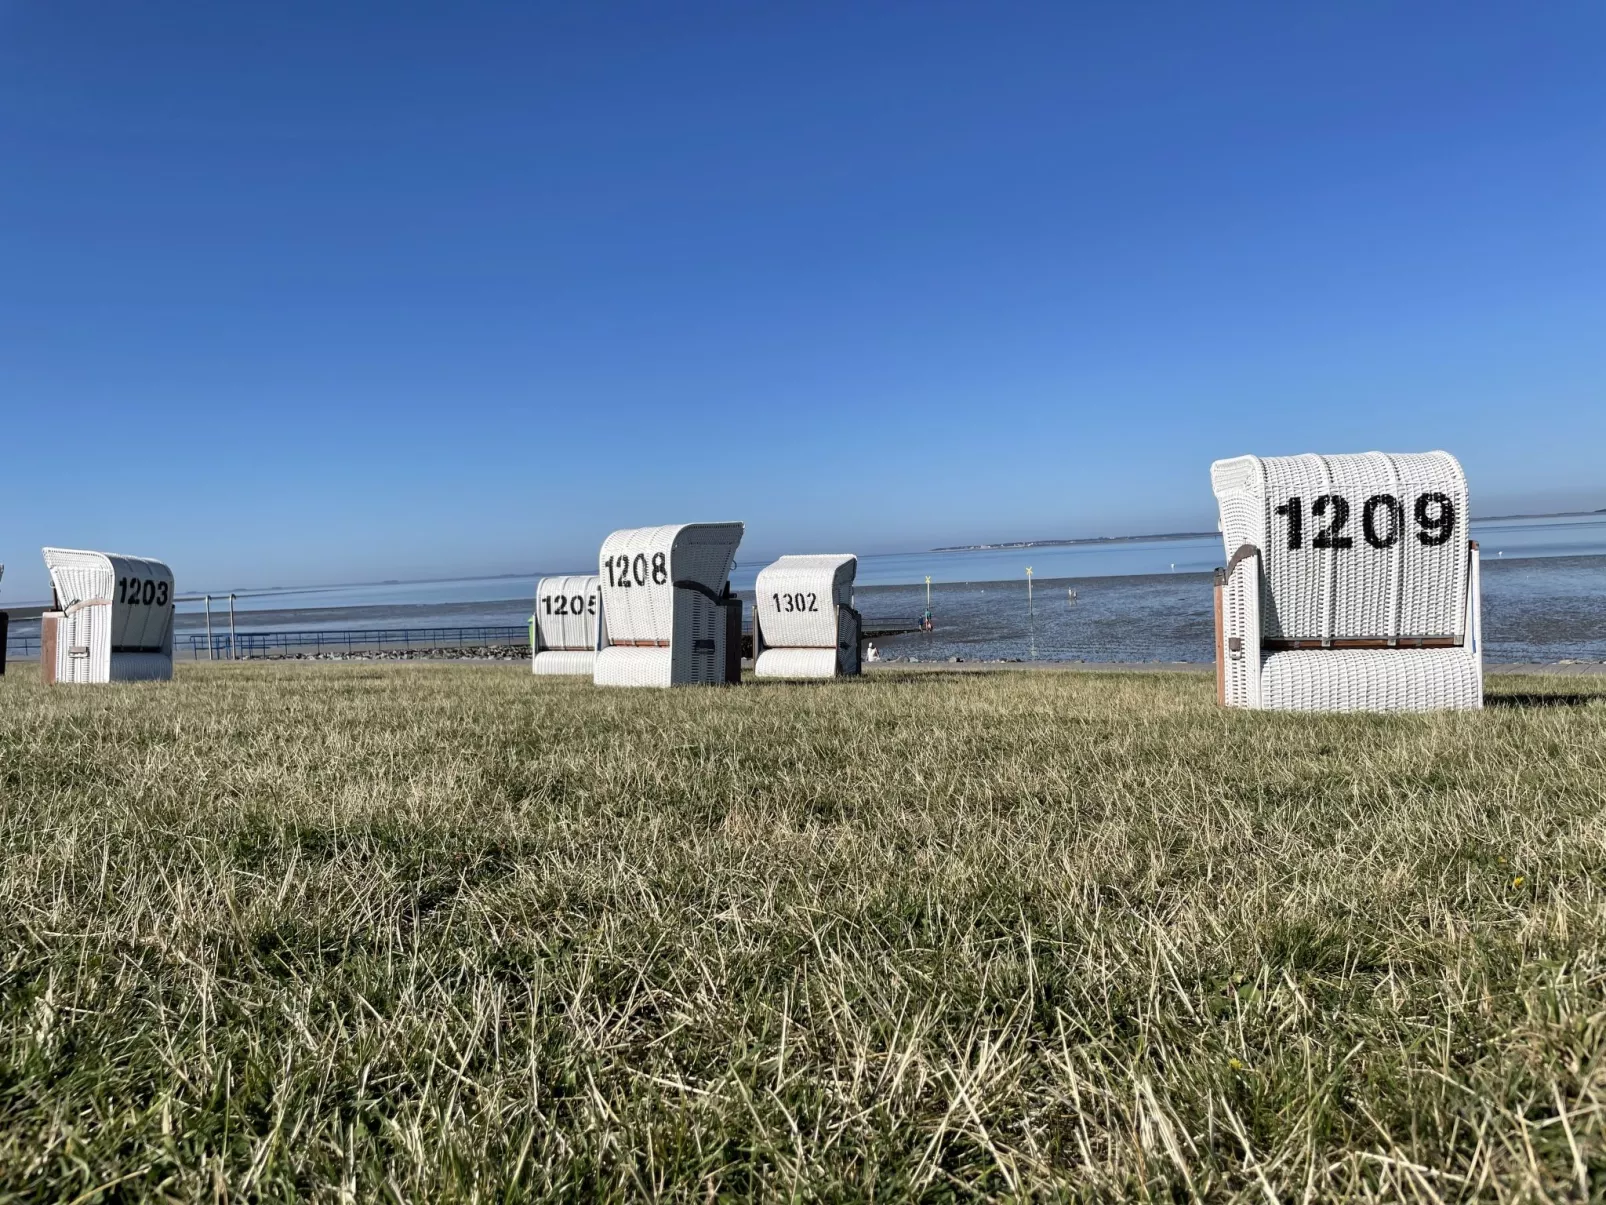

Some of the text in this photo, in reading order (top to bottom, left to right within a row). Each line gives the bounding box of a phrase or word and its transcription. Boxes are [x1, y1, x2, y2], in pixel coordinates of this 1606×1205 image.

[1275, 492, 1455, 550] 1209
[605, 552, 667, 588] 1208
[119, 577, 168, 606] 1203
[772, 592, 818, 613] 1302
